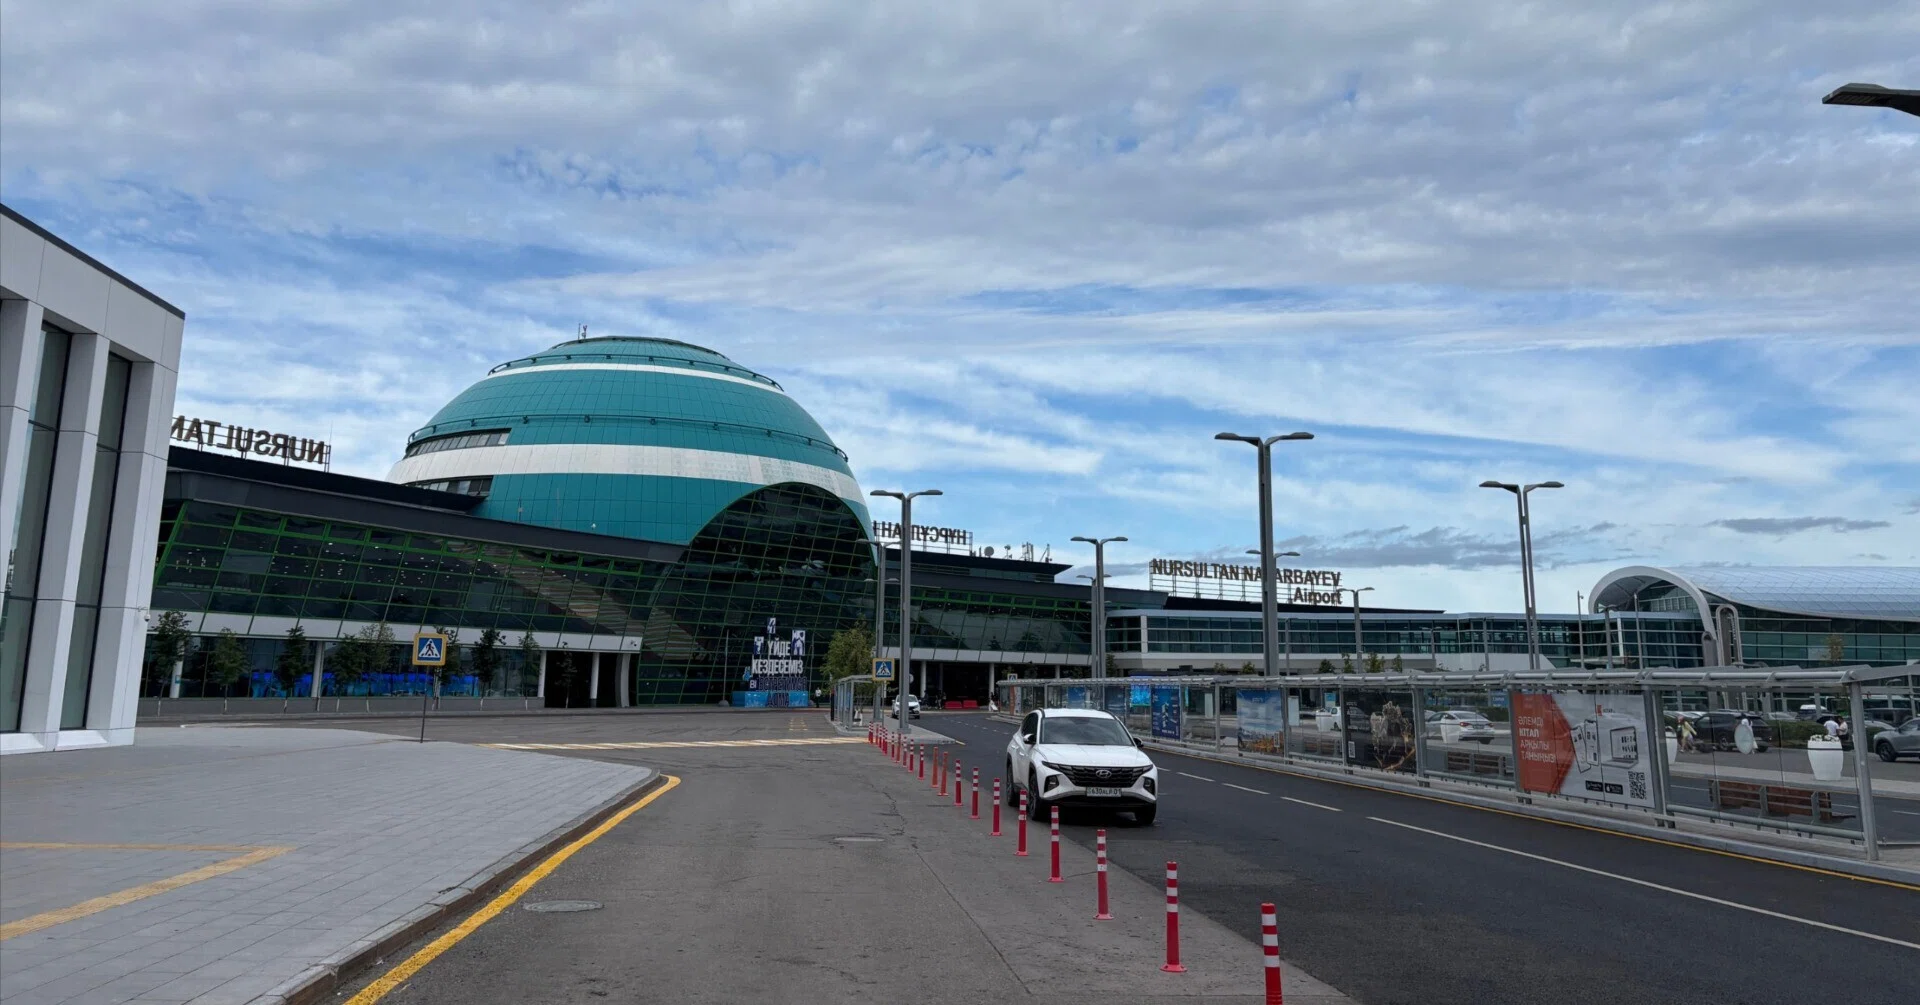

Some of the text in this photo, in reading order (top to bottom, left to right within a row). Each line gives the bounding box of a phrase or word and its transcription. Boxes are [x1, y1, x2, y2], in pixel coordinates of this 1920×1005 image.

[1152, 558, 1341, 587] NURSULTAN NAARBAYEV
[1293, 587, 1342, 606] Airport
[752, 659, 804, 675] КЕЗДЕСЕМІЗ
